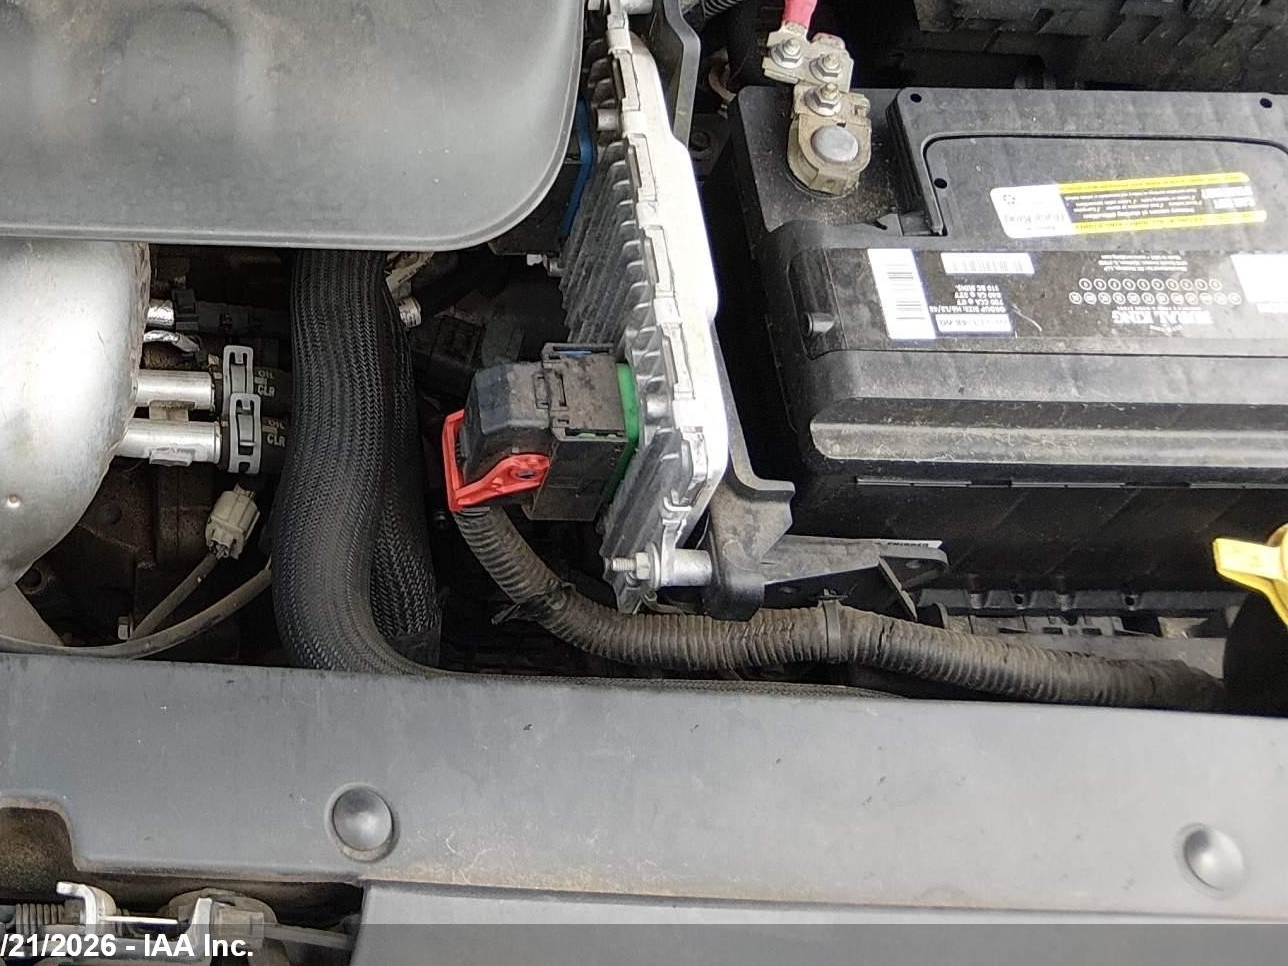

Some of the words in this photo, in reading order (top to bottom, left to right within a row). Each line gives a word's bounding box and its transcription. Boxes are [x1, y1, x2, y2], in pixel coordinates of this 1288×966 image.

[1111, 310, 1153, 324] KING
[257, 370, 274, 378] OIL
[257, 385, 275, 397] CLR
[268, 419, 285, 429] OIL
[266, 433, 286, 447] CLR
